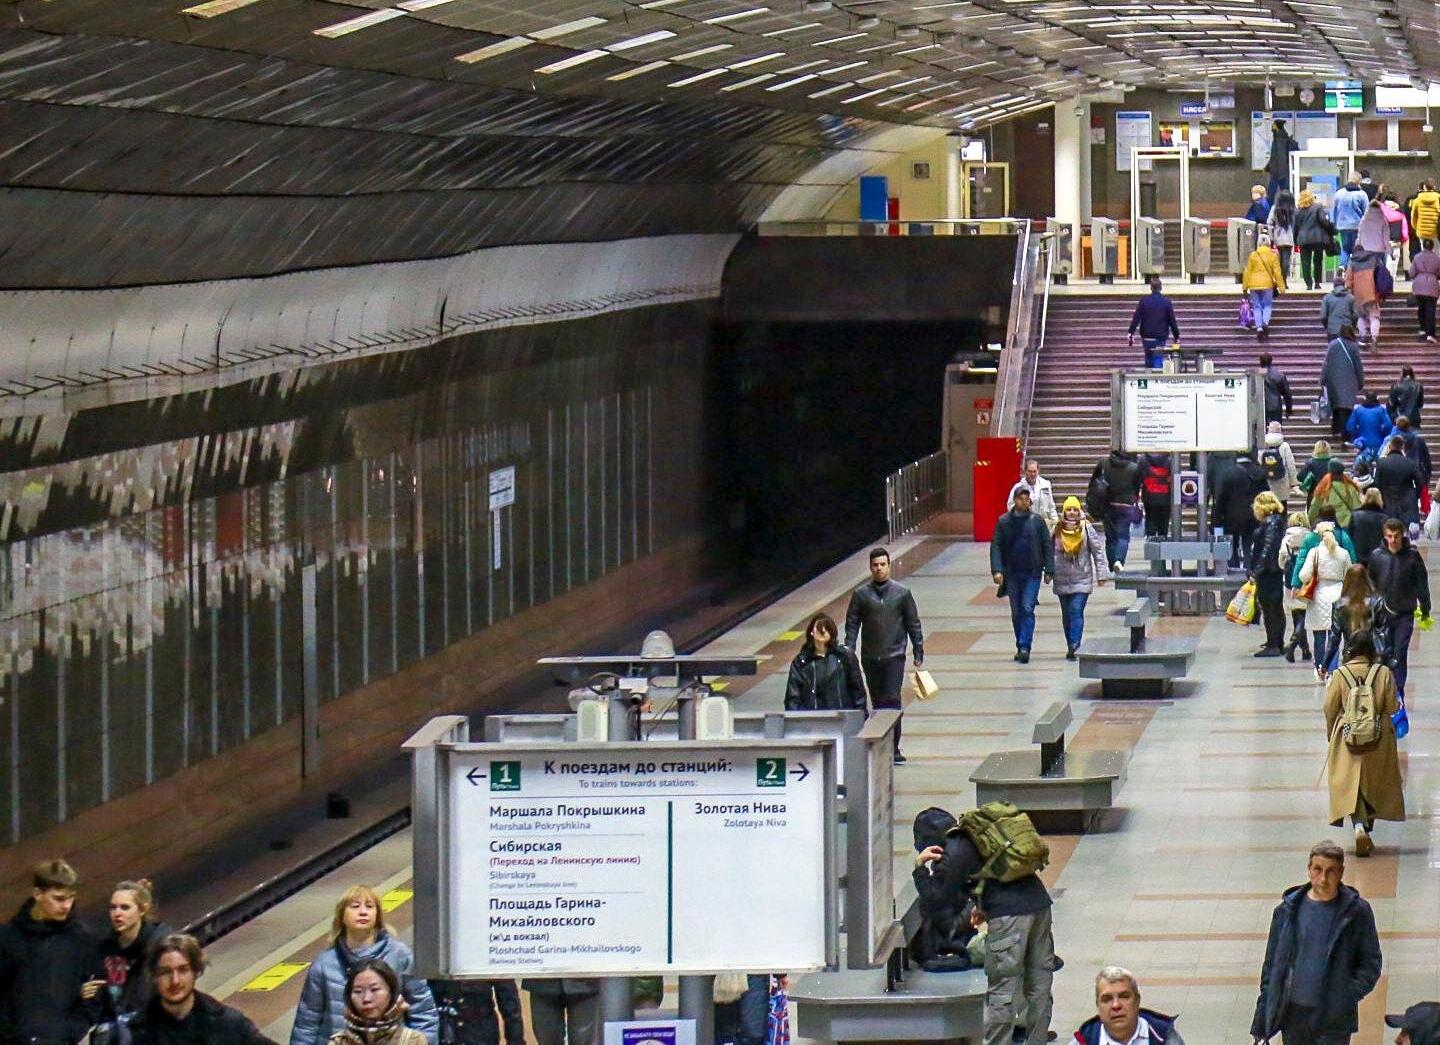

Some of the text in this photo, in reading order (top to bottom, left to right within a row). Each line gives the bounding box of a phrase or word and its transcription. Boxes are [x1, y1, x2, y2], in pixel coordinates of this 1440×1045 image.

[500, 763, 513, 783] 1
[544, 758, 733, 777] К поездам до станций:
[766, 760, 778, 779] 2
[579, 778, 698, 788] To trains towards stations:
[489, 804, 645, 819] Маршала Покрышкина
[695, 802, 786, 814] Золотая Нива
[490, 821, 591, 832] Marshala Pokryshkina
[724, 818, 787, 829] Zolotaya Niva
[489, 840, 562, 854] Сибирская
[489, 856, 641, 868] (Переход на Ленинскую линию)
[489, 871, 536, 881] Sibirskaya
[489, 897, 607, 911] Площадь Гарина-
[489, 915, 596, 928] Михайловского
[513, 932, 550, 941] вокзал)
[489, 944, 642, 955] Ploshchad Garina-Mikhailovskogo
